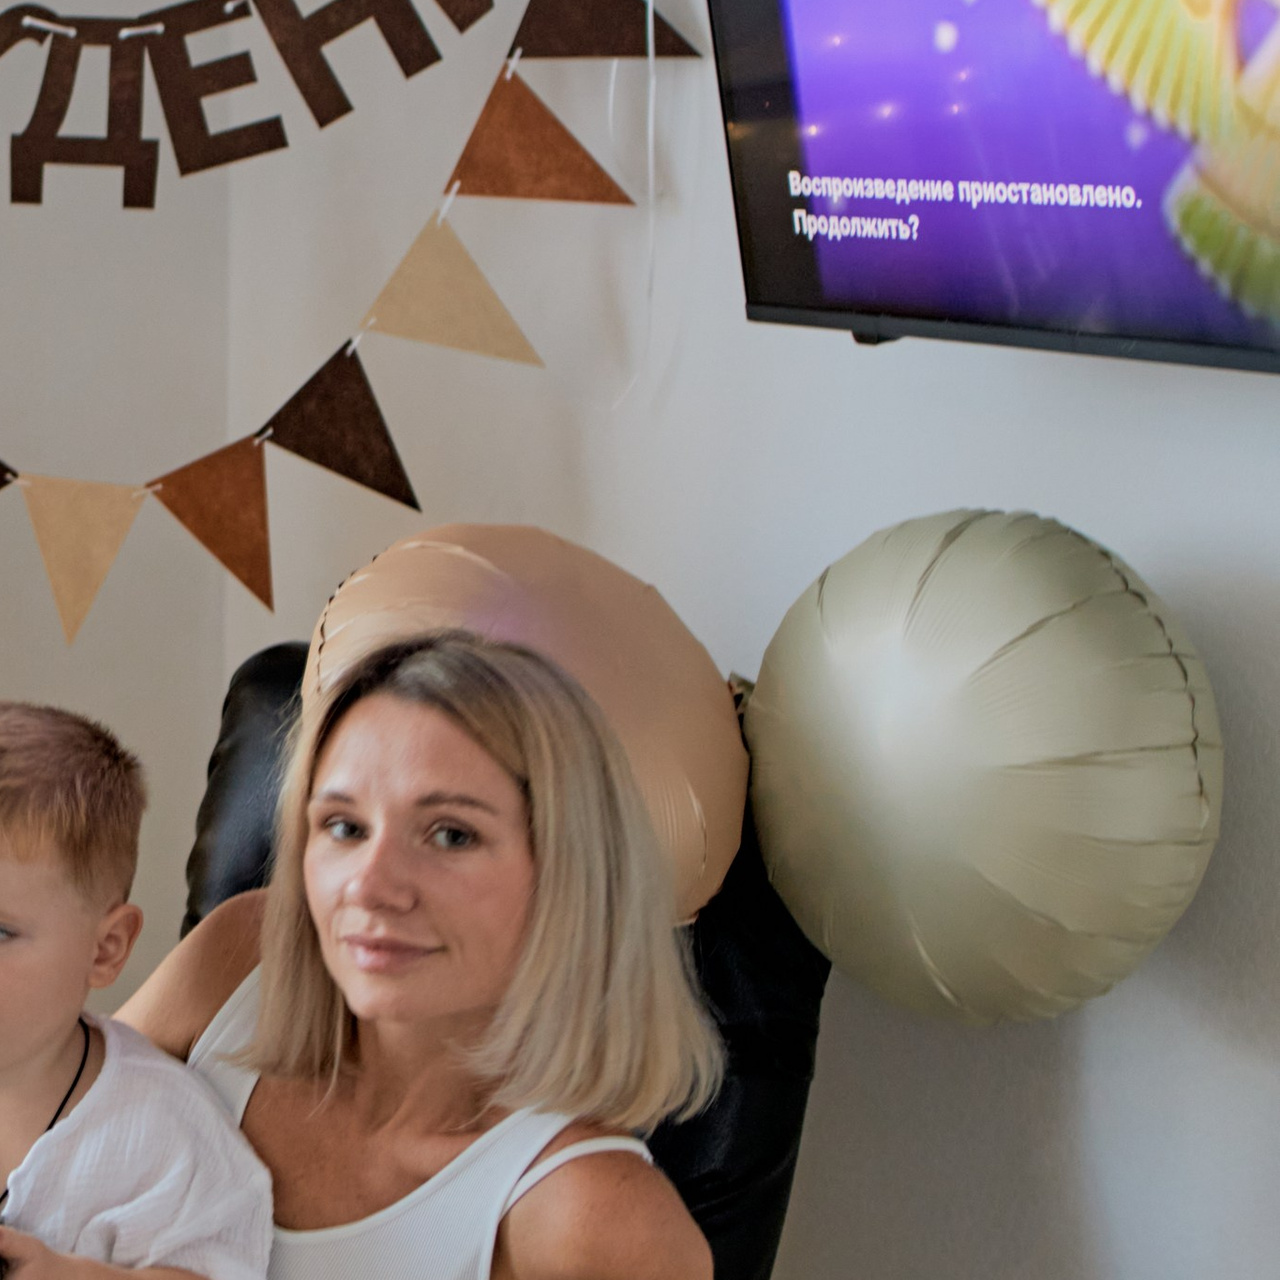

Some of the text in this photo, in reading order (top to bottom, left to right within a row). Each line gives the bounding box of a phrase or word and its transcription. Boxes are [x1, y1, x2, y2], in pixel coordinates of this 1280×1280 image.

[788, 170, 1143, 209] Воспроизведение приостановлено.
[793, 209, 920, 241] Продолжить?
